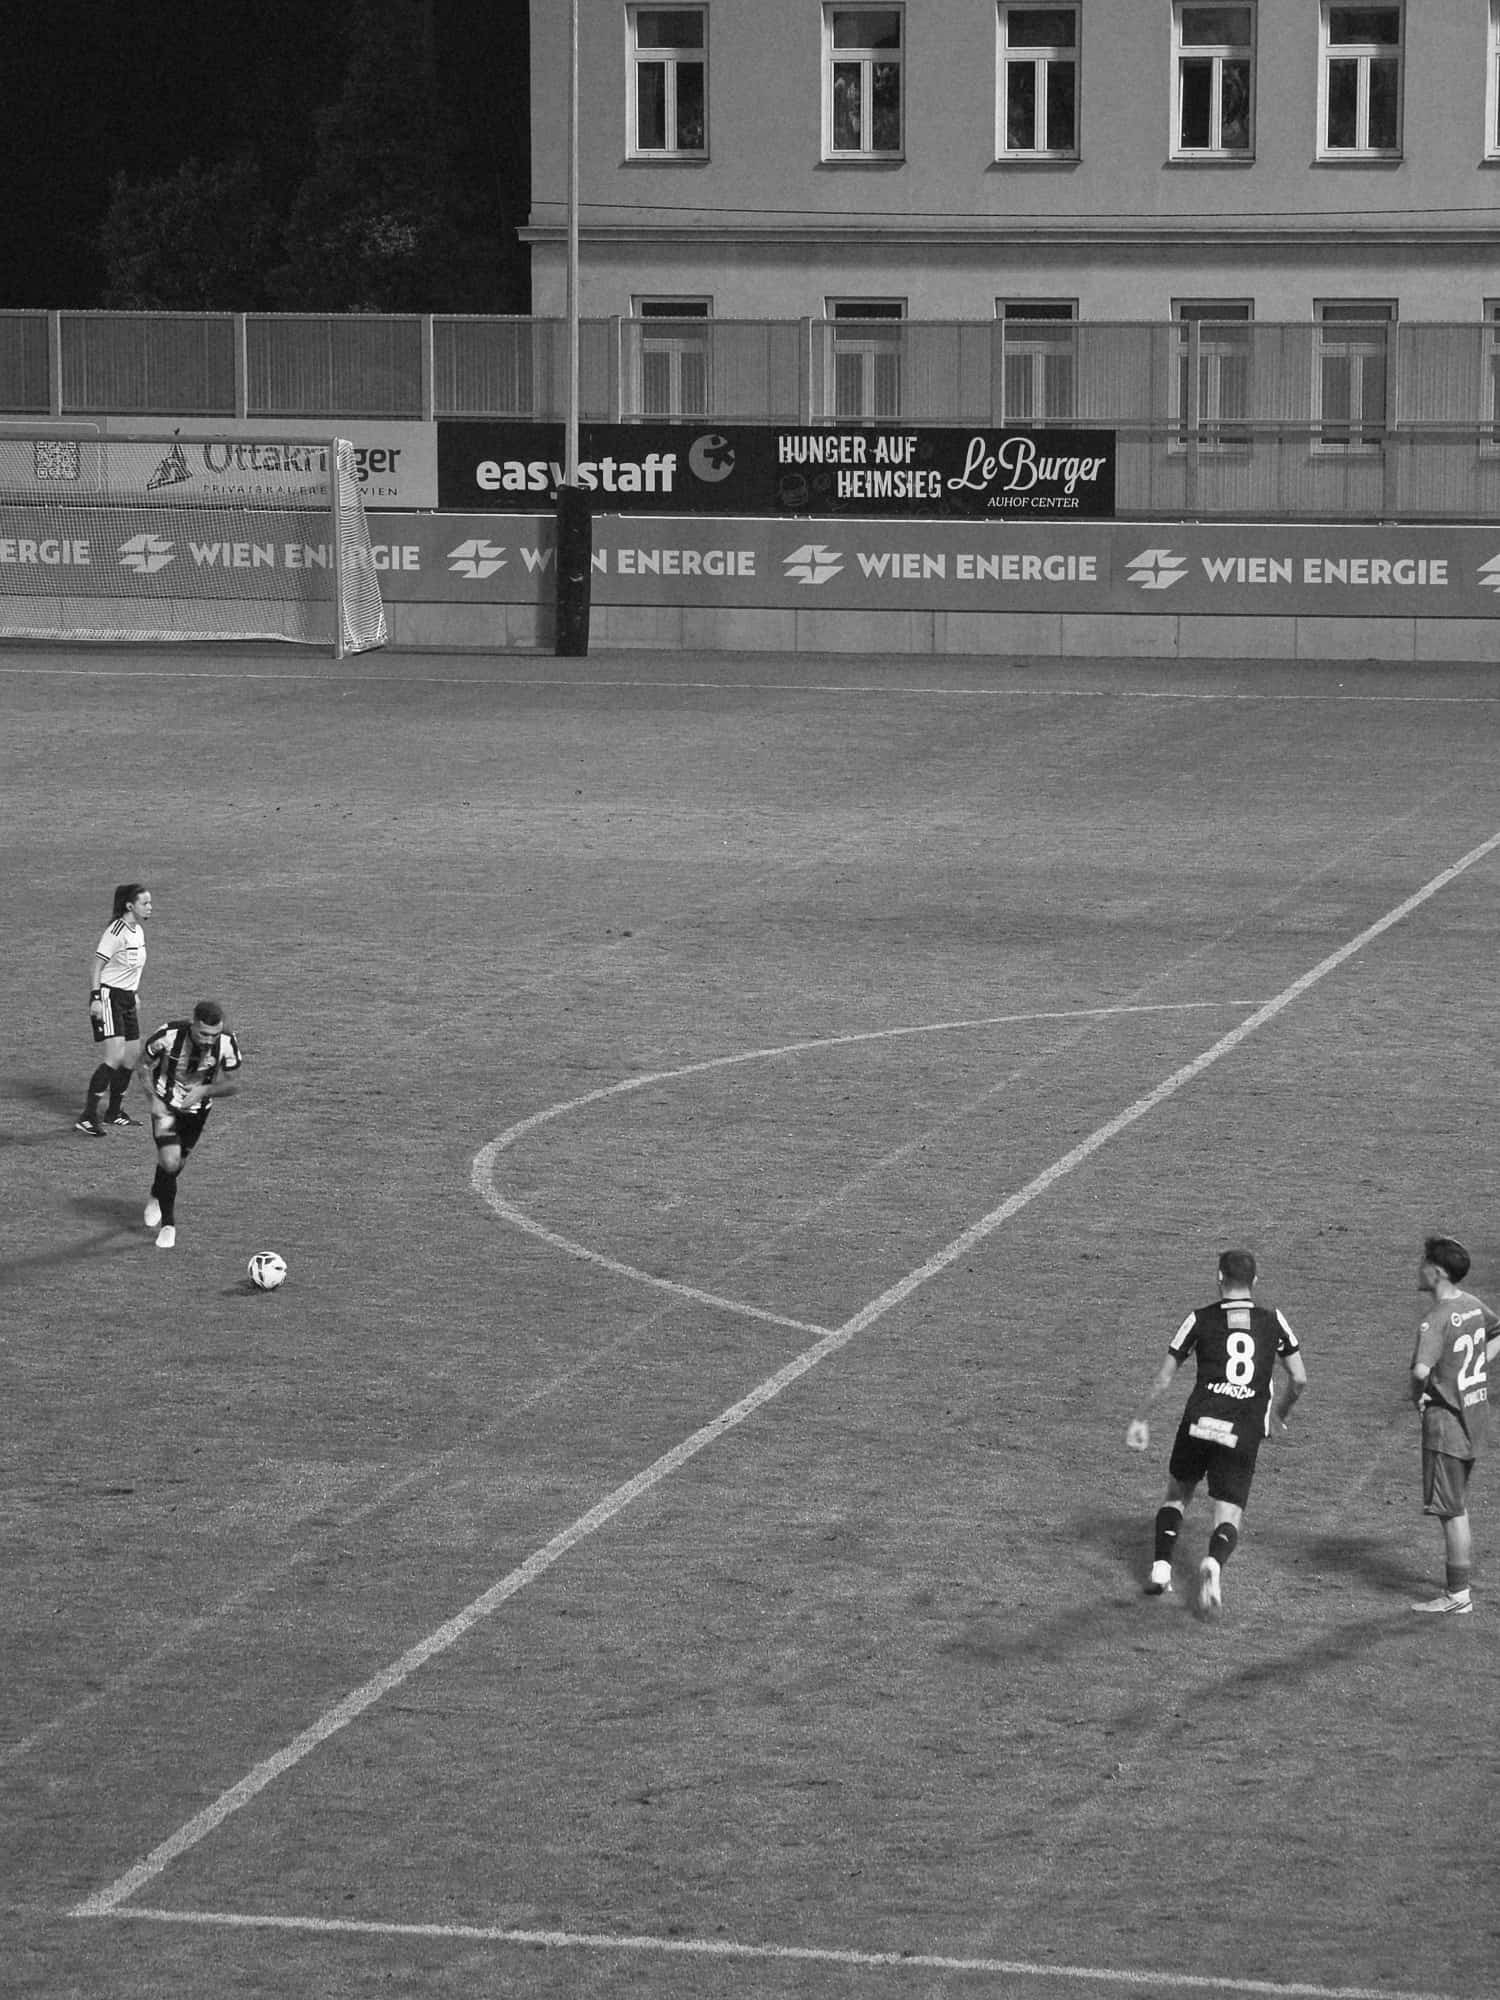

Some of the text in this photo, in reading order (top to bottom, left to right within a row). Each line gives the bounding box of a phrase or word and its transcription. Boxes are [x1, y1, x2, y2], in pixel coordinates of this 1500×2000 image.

[779, 435, 917, 464] HUNGER AUF
[947, 436, 1106, 494] Le Burger
[837, 470, 941, 498] HEIMSIEG
[987, 496, 1080, 508] AUHOF CENTER
[189, 542, 421, 571] WIEN ENGIE
[519, 546, 756, 576] WN ENERGIE
[856, 553, 1097, 581] WIEN ENERGIE
[1201, 557, 1449, 585] WIEN ENERGIE
[1225, 1331, 1255, 1386] 8
[1453, 1327, 1487, 1391] 22
